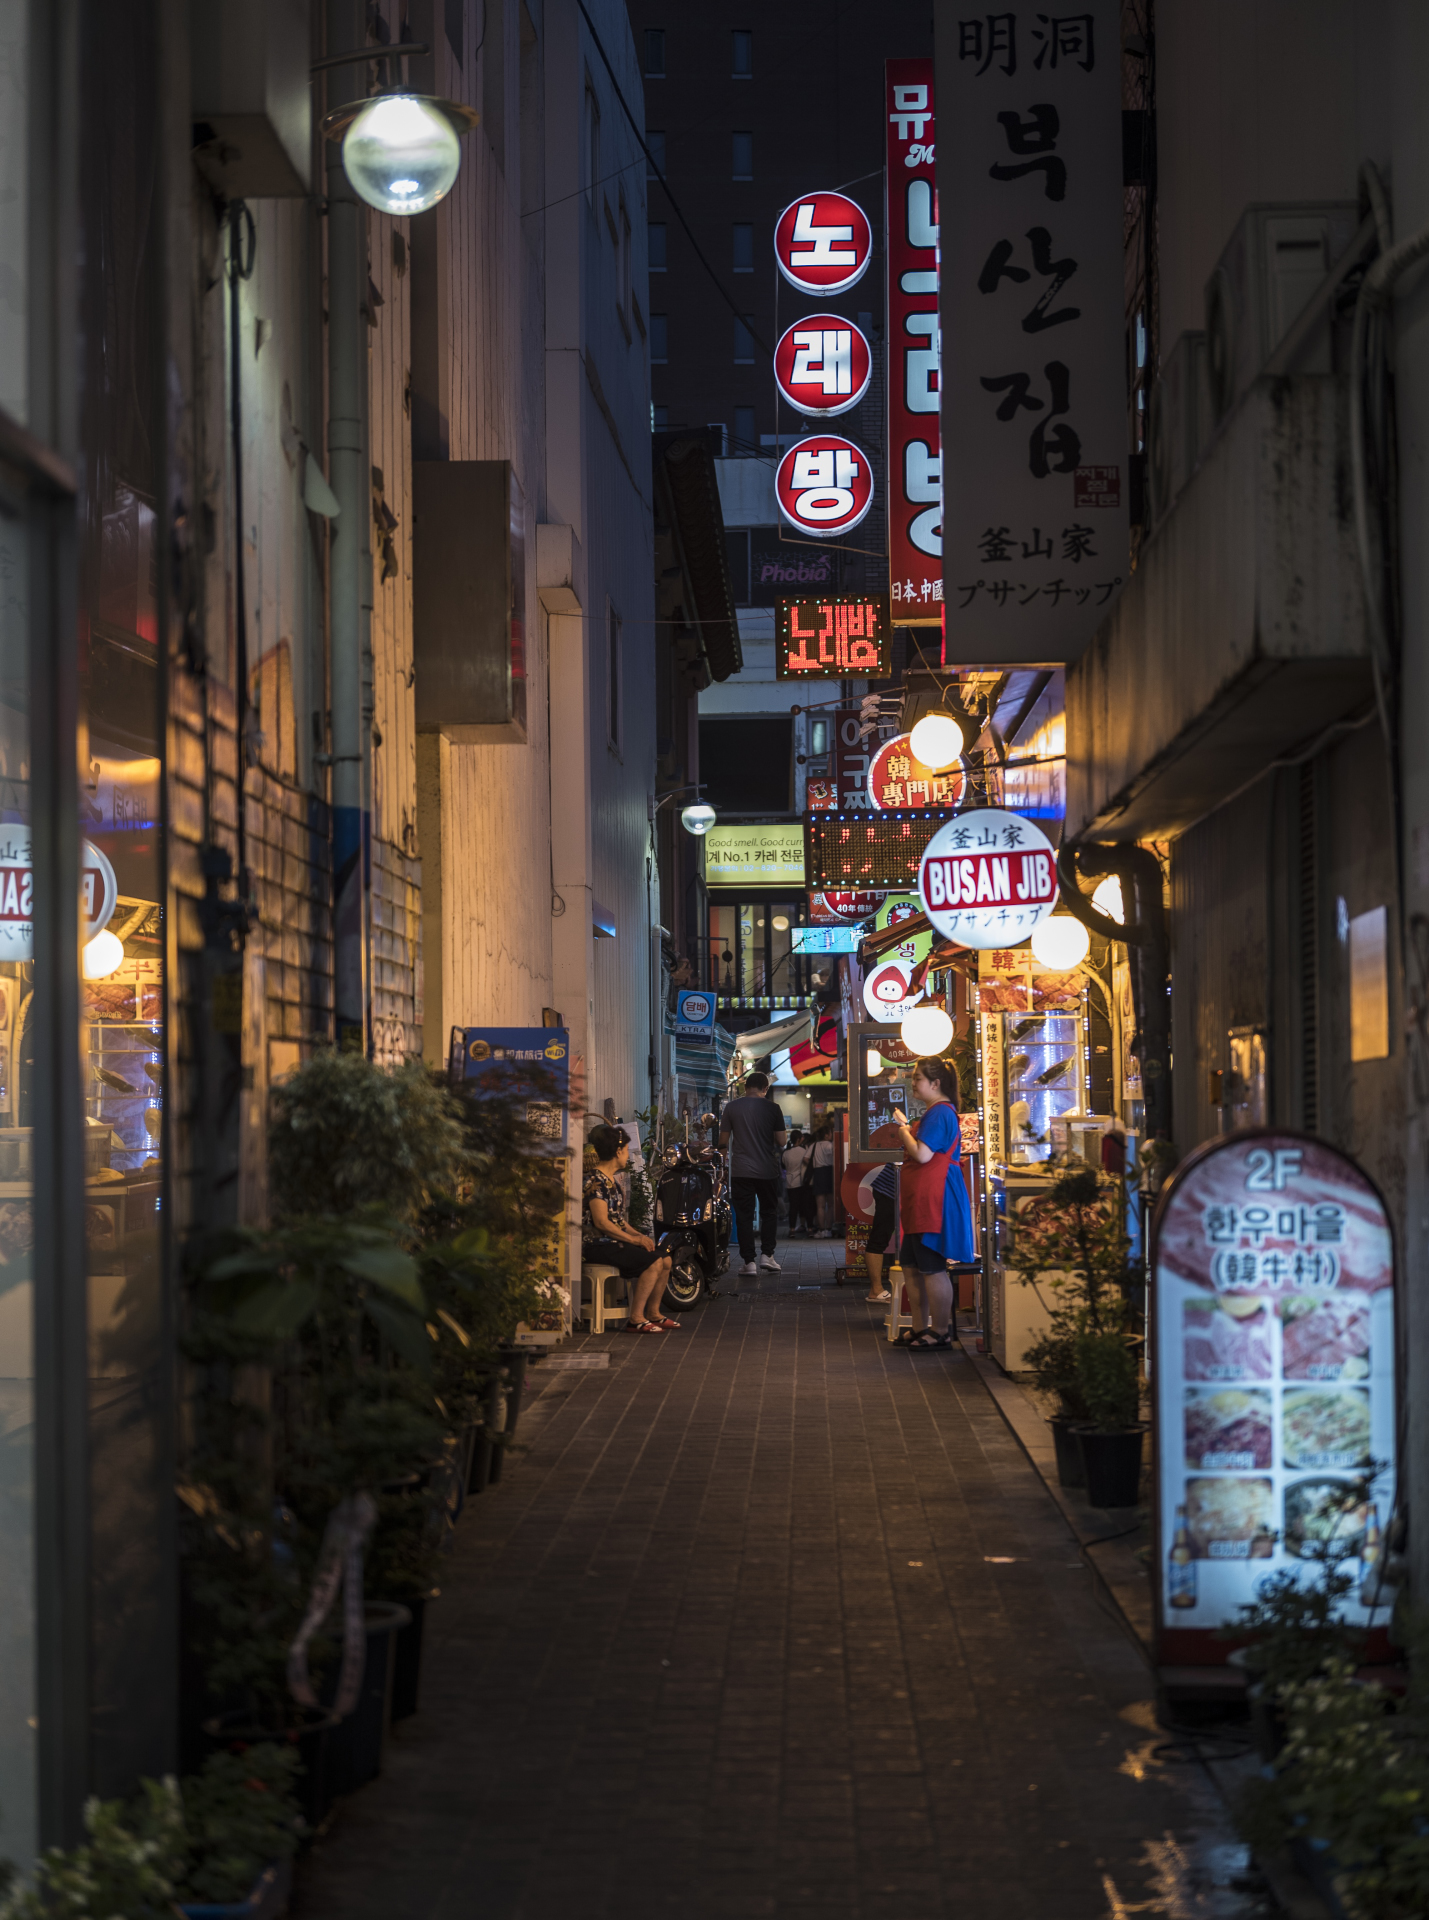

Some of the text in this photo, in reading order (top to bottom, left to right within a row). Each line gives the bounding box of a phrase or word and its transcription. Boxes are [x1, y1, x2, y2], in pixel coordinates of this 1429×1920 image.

[957, 12, 1095, 77] 明洞
[889, 84, 935, 140] 뮤
[904, 143, 936, 168] M
[977, 103, 1082, 479] 부산집
[789, 203, 860, 522] 노래방
[976, 523, 1100, 564] 釜山家
[760, 560, 828, 582] Phobia
[957, 575, 1124, 610] プサンチップ
[881, 778, 955, 808] 專門店
[708, 837, 804, 847] Good smell. Good curr
[948, 822, 1026, 852] 釜山家
[723, 850, 749, 862] No.1
[754, 849, 777, 863] 카레
[780, 849, 804, 863] 전문
[928, 848, 1052, 907] BUSAN JIB
[948, 904, 1043, 931] プサンチップ
[991, 949, 1036, 972] 韓牛
[685, 1001, 707, 1013] 담배
[1243, 1148, 1304, 1192] 2F
[1203, 1203, 1346, 1246] 한우마을
